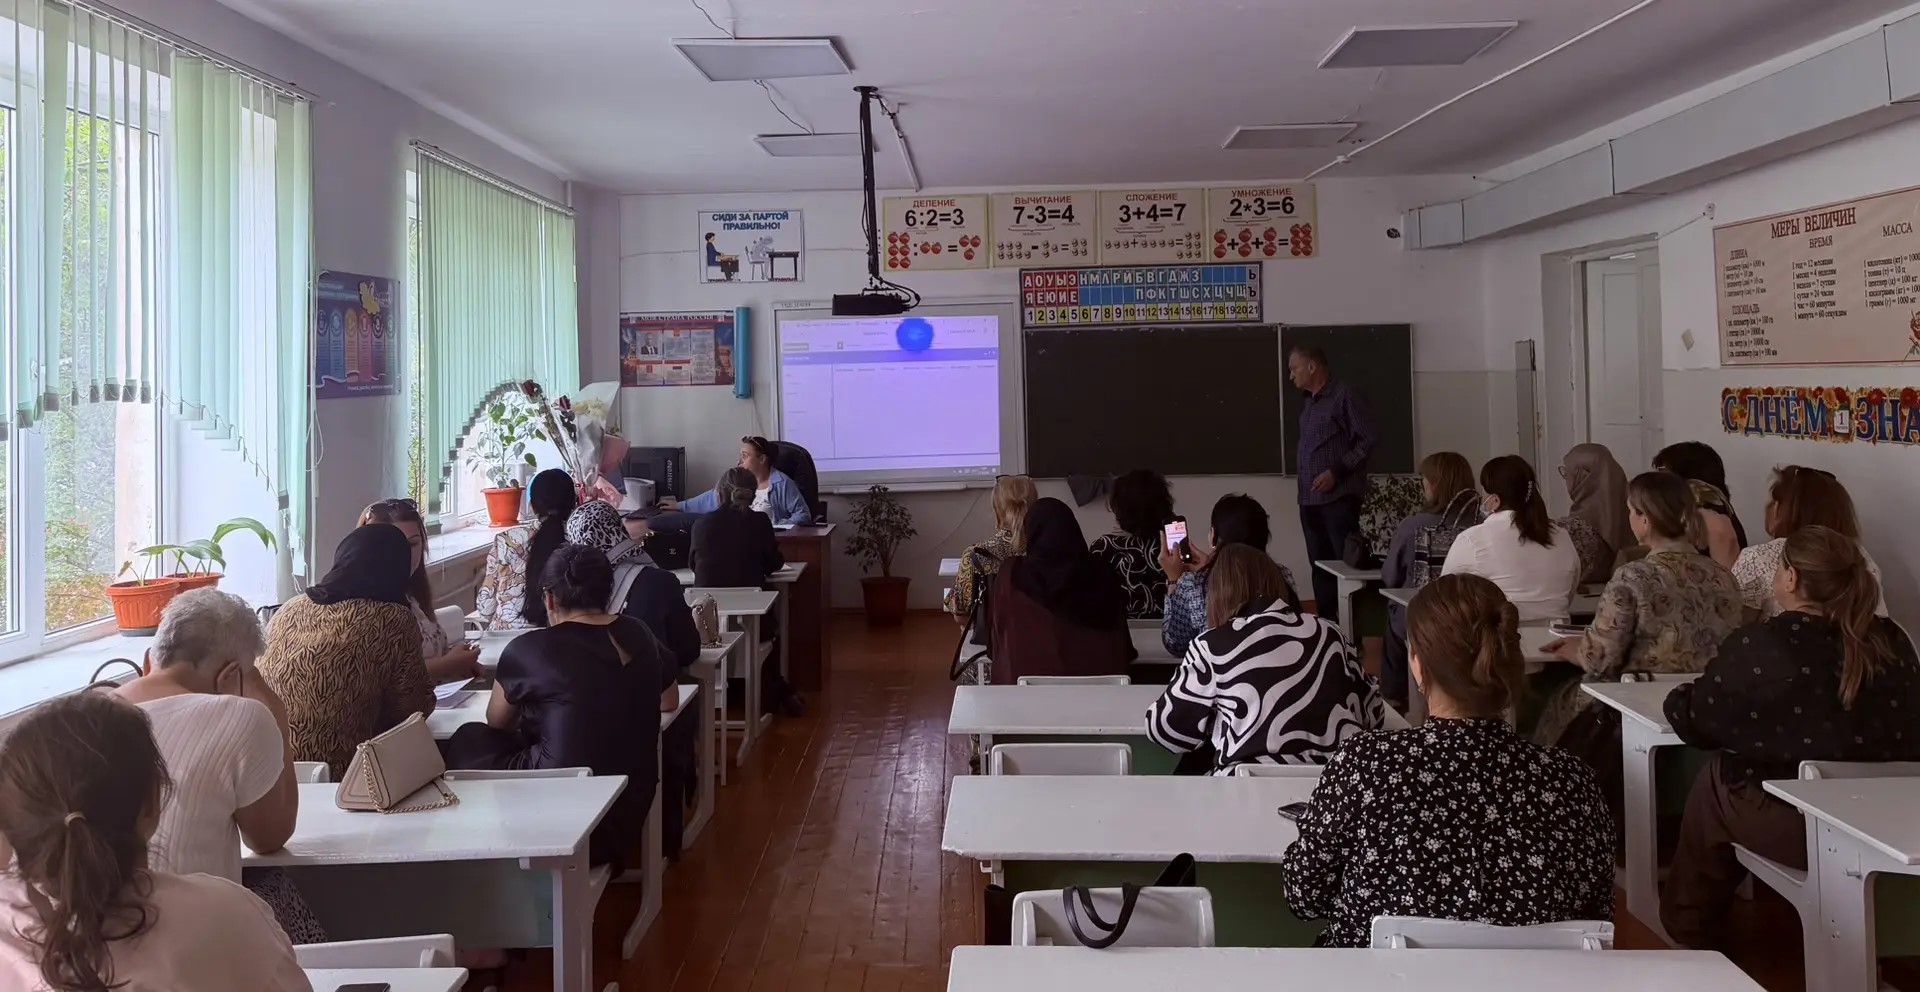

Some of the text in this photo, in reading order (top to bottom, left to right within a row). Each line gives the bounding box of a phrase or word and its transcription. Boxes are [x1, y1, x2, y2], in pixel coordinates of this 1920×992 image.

[1014, 196, 1072, 205] ВЫЧИТАНИЕ
[1125, 193, 1178, 202] СЛОЖЕНИЕ
[1231, 188, 1292, 198] УМНОЖЕНИЕ
[913, 199, 956, 208] ДЕЛЕНИЕ
[712, 211, 789, 222] СИДИ ЗА ПАРТОЙ
[905, 208, 964, 227] 6:2=3
[1013, 204, 1075, 224] 7-3=4
[1119, 203, 1187, 223] 3+4=7
[723, 221, 780, 231] ПРАВИЛЬНО!
[1771, 207, 1857, 239] МЕРЫ ВЕЛИЧИН
[1882, 222, 1913, 237] МАССА
[1809, 235, 1833, 249] ВРЕМЯ
[1028, 303, 1258, 321] 1 2 3 4 5 6 7 8 9 10 11 12 13 14 15 16 17 18 19 20 21
[1723, 389, 1920, 445] С ДНЁМ ЗНА
[1838, 409, 1845, 426] 1
